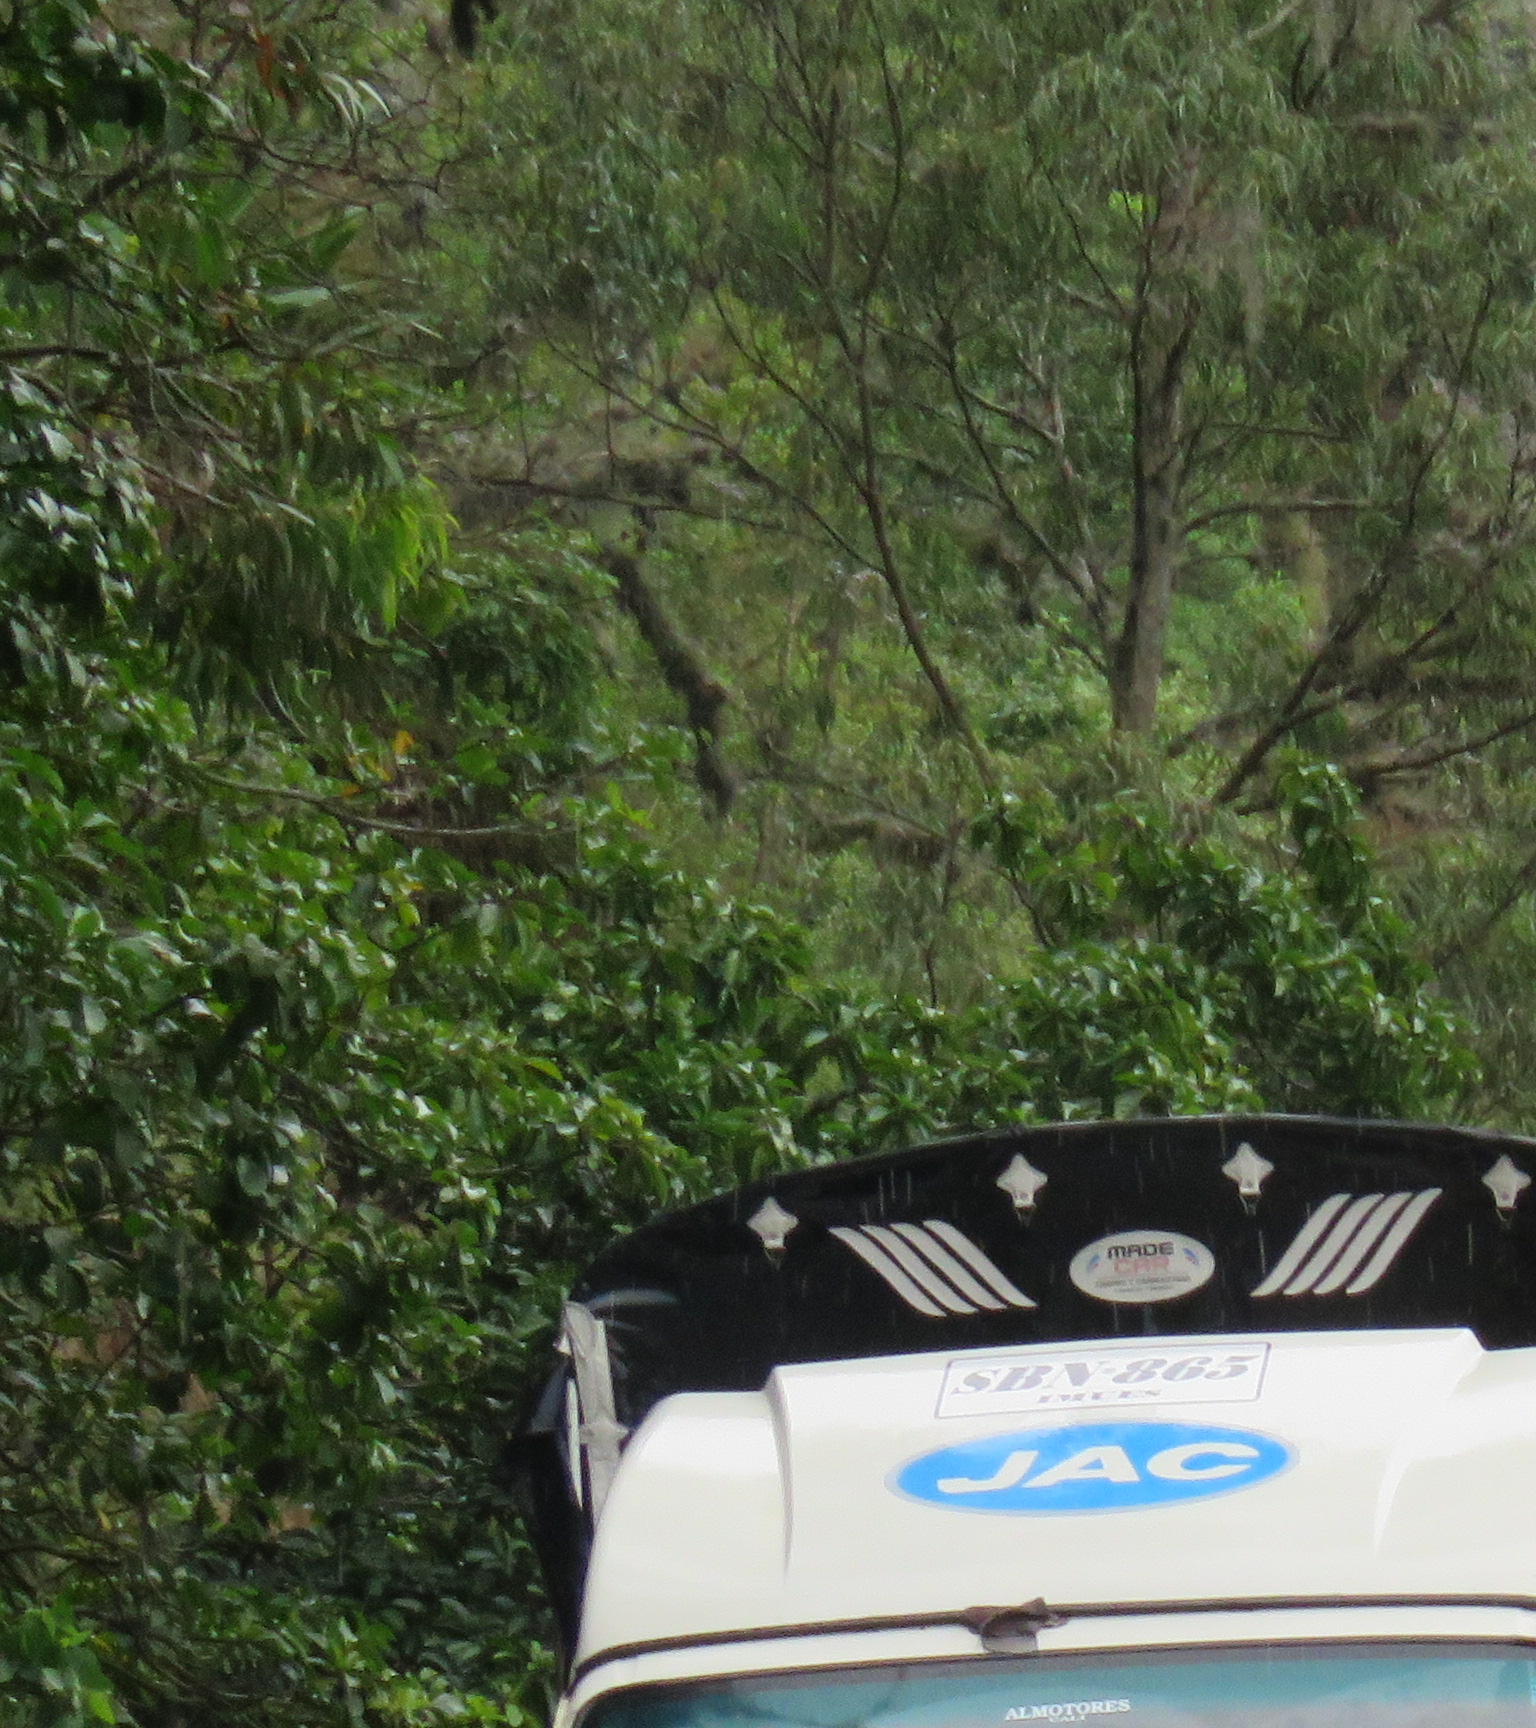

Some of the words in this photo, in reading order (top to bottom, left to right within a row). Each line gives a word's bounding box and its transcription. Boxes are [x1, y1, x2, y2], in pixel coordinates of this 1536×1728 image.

[1107, 1241, 1174, 1259] MADE
[1114, 1256, 1170, 1275] CAR
[937, 1441, 1260, 1494] JAC
[1004, 1699, 1132, 1721] ALMOTORES
